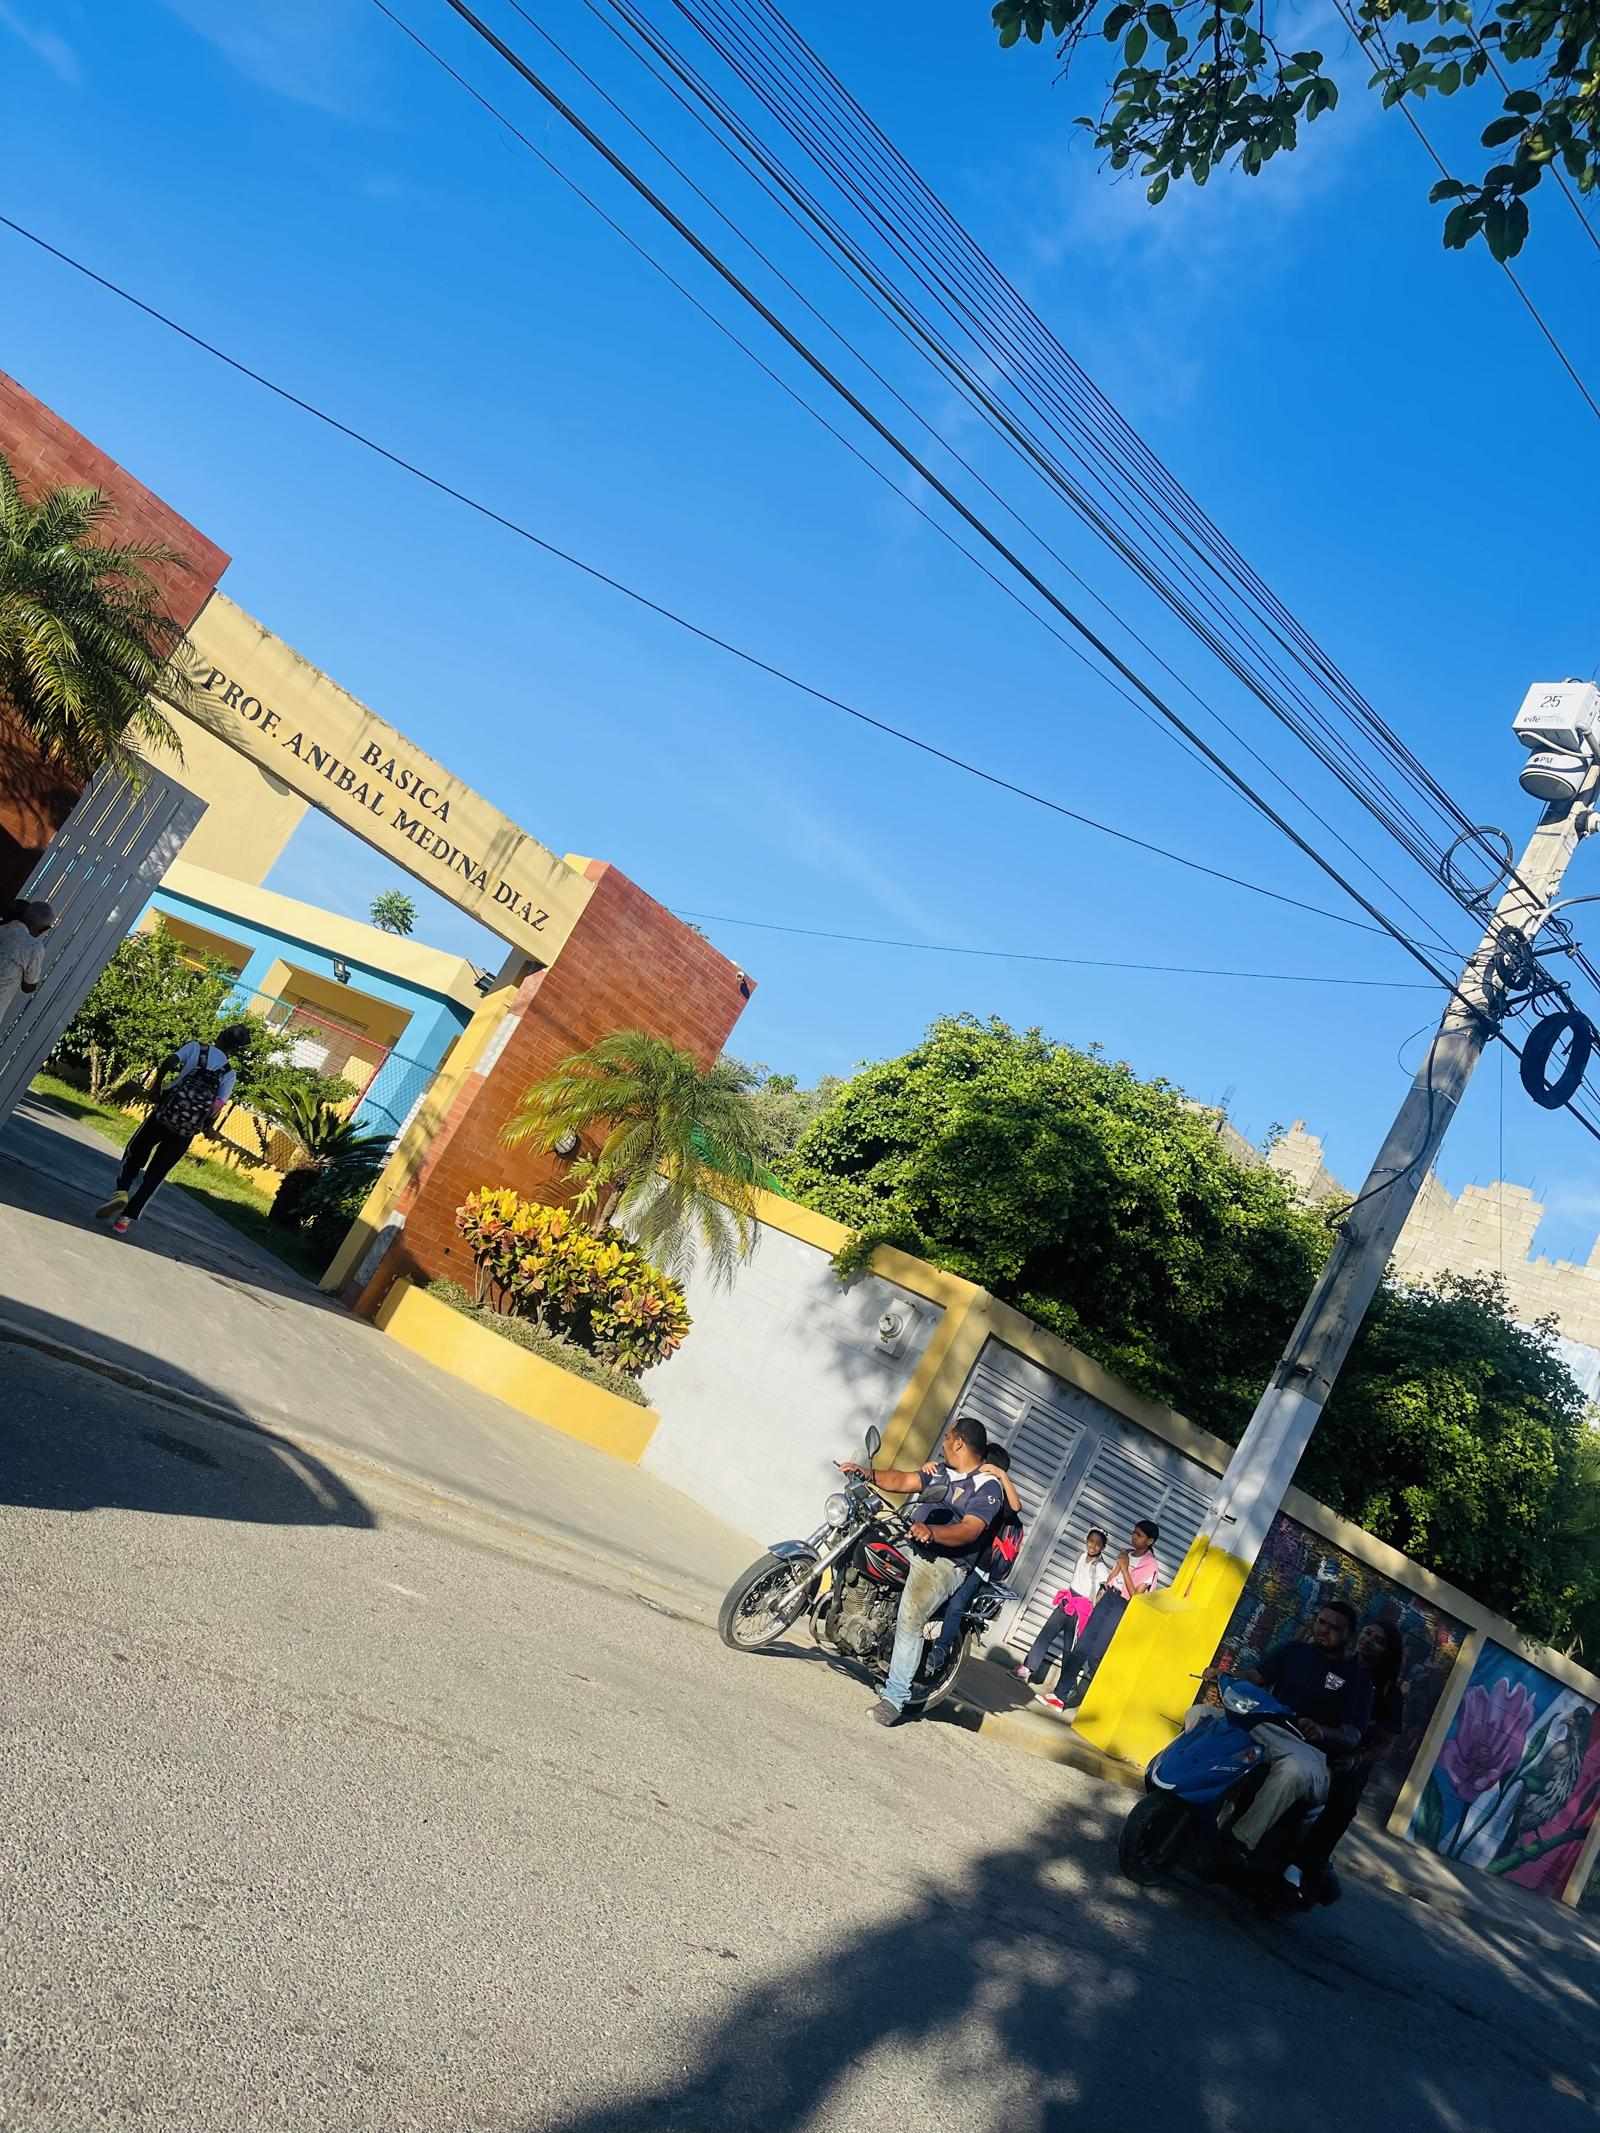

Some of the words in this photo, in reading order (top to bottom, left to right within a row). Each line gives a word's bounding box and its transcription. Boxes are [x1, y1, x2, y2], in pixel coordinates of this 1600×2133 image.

[1540, 695, 1563, 708] 25
[201, 666, 281, 738] PROF.
[281, 732, 385, 816] ANIBAL
[390, 807, 489, 892] MEDINA
[492, 880, 550, 932] DIAZ
[360, 741, 451, 823] BASICA
